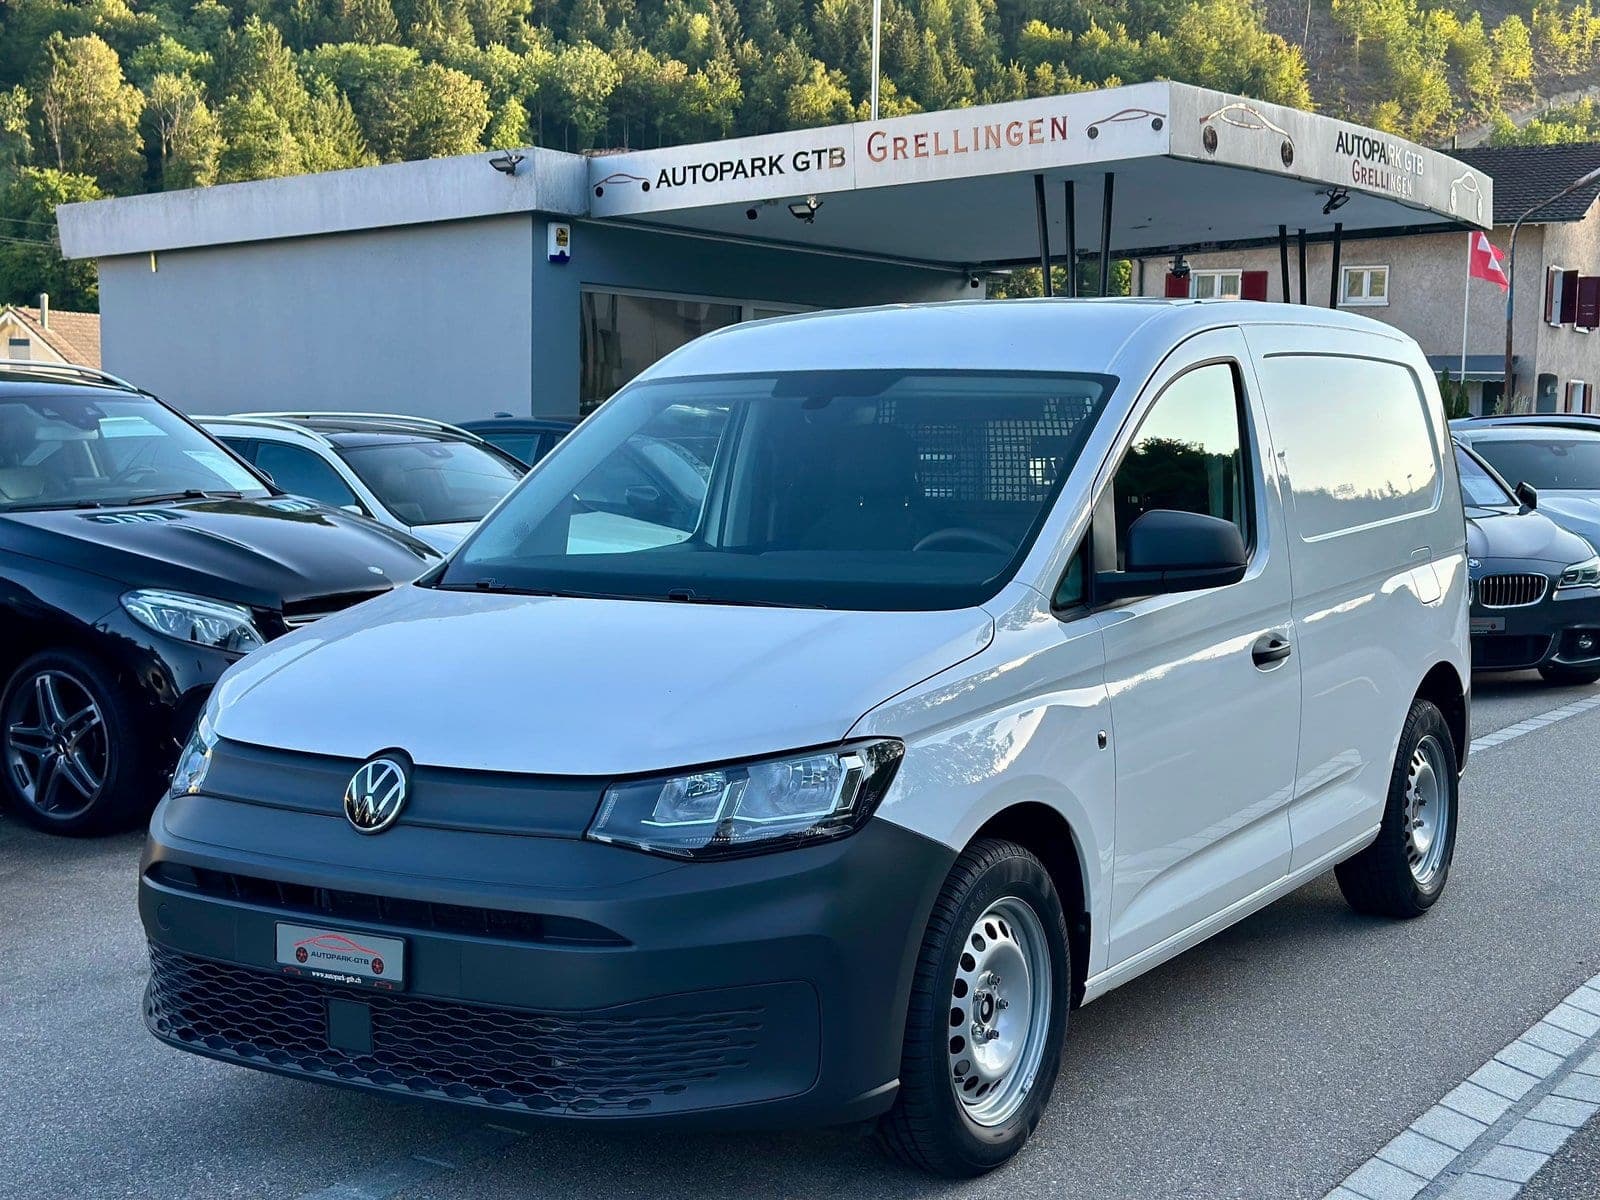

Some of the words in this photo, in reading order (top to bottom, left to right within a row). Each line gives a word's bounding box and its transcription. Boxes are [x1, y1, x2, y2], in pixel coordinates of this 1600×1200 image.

[655, 153, 785, 189] AUTOPARK
[792, 146, 846, 173] GTB
[866, 115, 1068, 163] GRELLINGEN
[1335, 130, 1402, 169] AUTOPARK
[1404, 150, 1424, 176] GTB
[1352, 159, 1412, 197] GRELLINGEN
[310, 951, 369, 965] AUTOPARK-GTB
